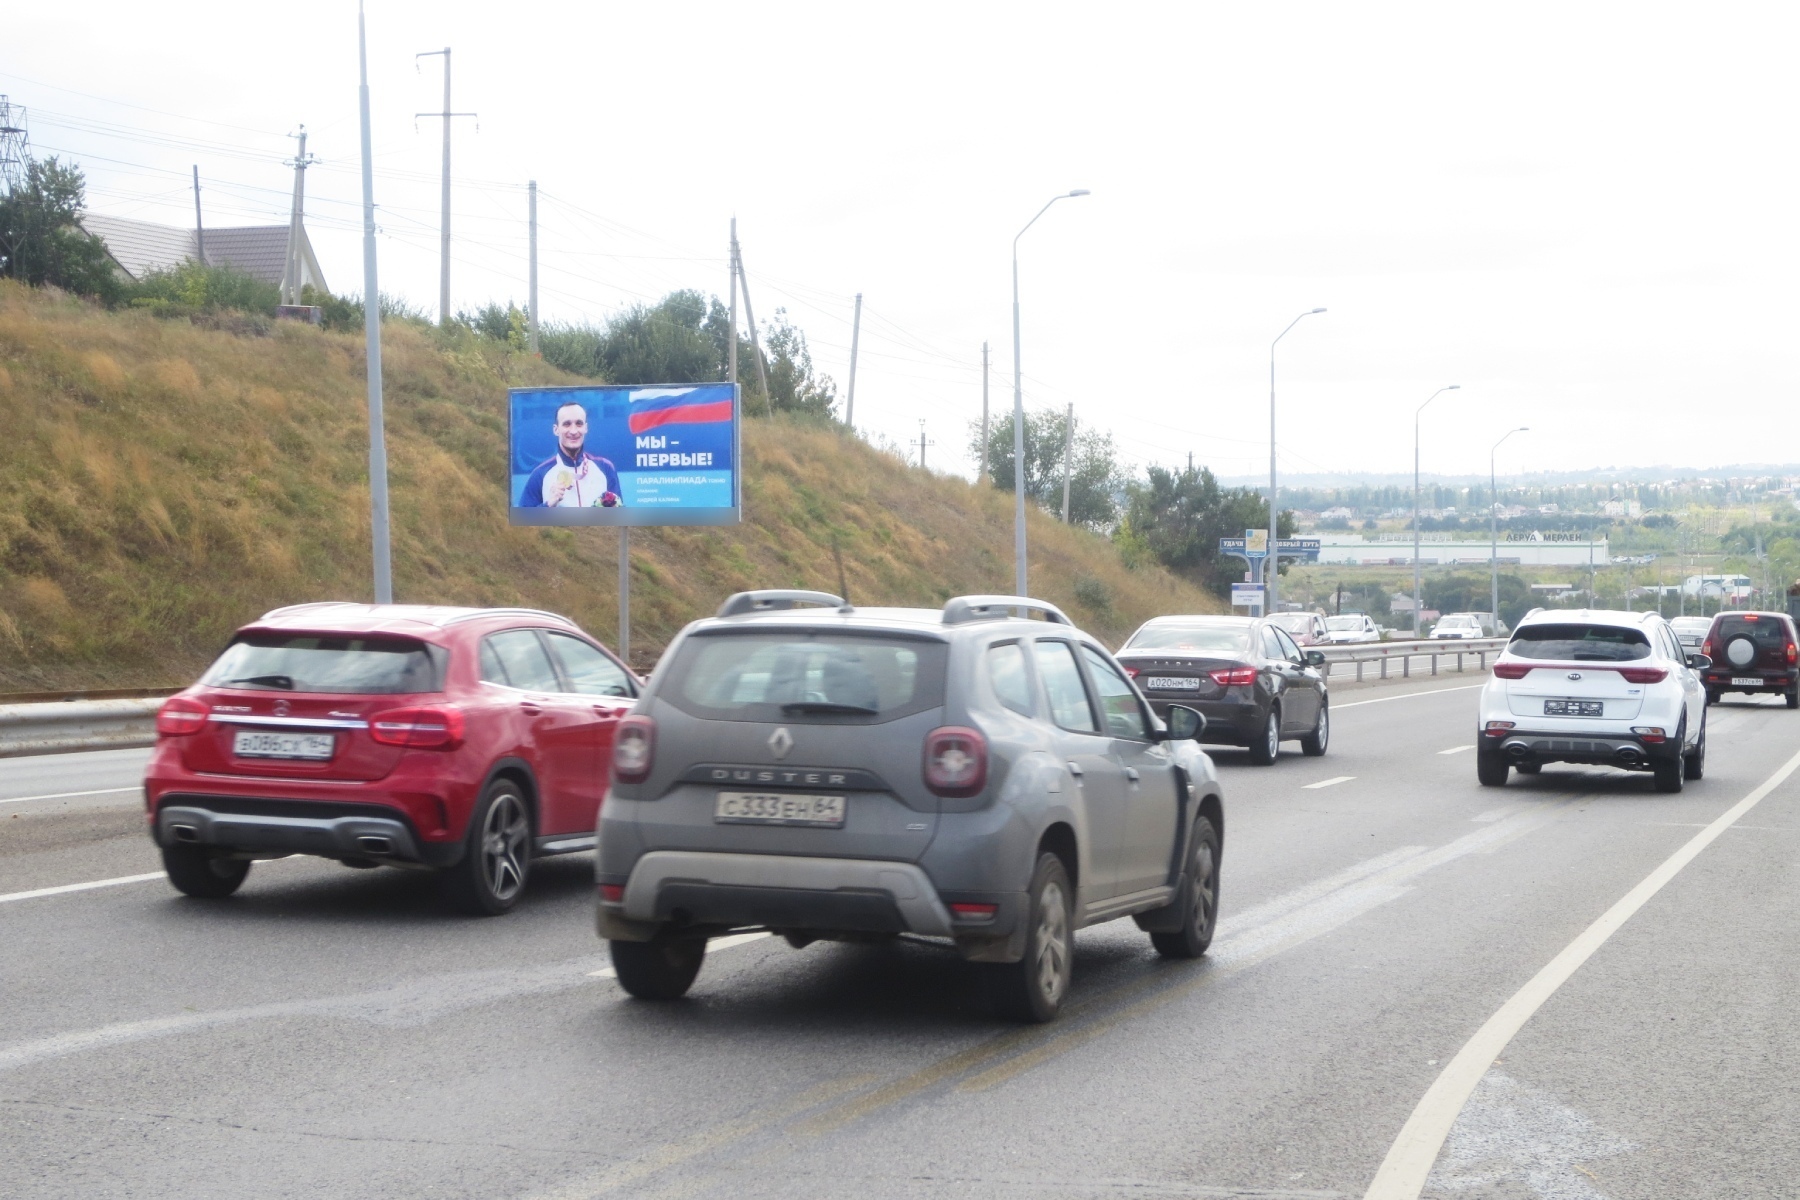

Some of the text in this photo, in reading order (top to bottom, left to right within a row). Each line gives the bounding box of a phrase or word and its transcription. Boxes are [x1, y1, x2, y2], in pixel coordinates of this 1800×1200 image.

[636, 435, 666, 449] МЫ
[636, 452, 713, 467] ПЕРВЫЕ!
[636, 476, 707, 485] ПАРАЛИМПИАДА
[1506, 533, 1582, 542] ЛЕРУА МЕРЛЕН
[711, 769, 846, 785] DUSTER
